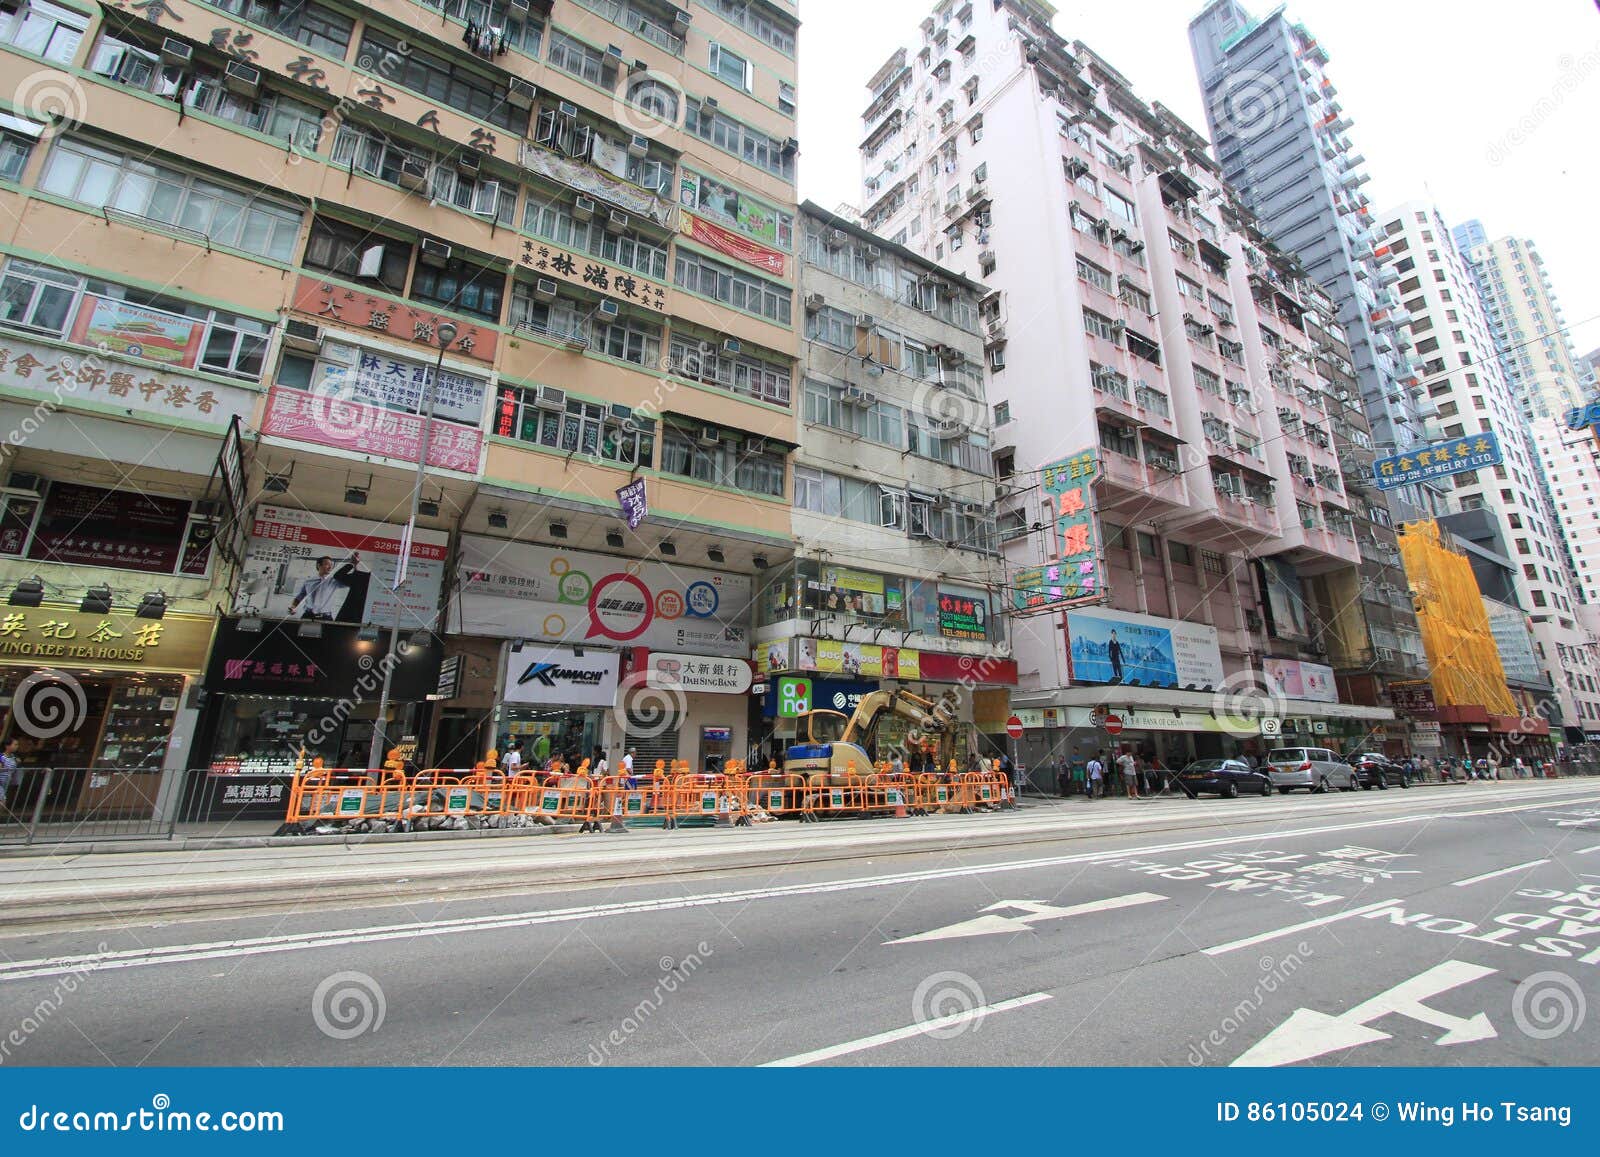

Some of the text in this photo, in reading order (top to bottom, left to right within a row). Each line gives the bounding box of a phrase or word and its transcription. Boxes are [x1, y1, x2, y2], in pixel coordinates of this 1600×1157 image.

[1382, 472, 1406, 486] WING
[1408, 469, 1421, 481] ON
[1423, 458, 1469, 477] JEWELRY
[0, 613, 164, 647] 英記茶莊
[34, 641, 65, 657] KEE
[68, 645, 97, 659] TEA
[98, 646, 144, 662] HOUSE
[550, 669, 603, 682] KAMACHI
[683, 662, 739, 677] 大新銀行
[224, 785, 284, 798] 萬福珠寶
